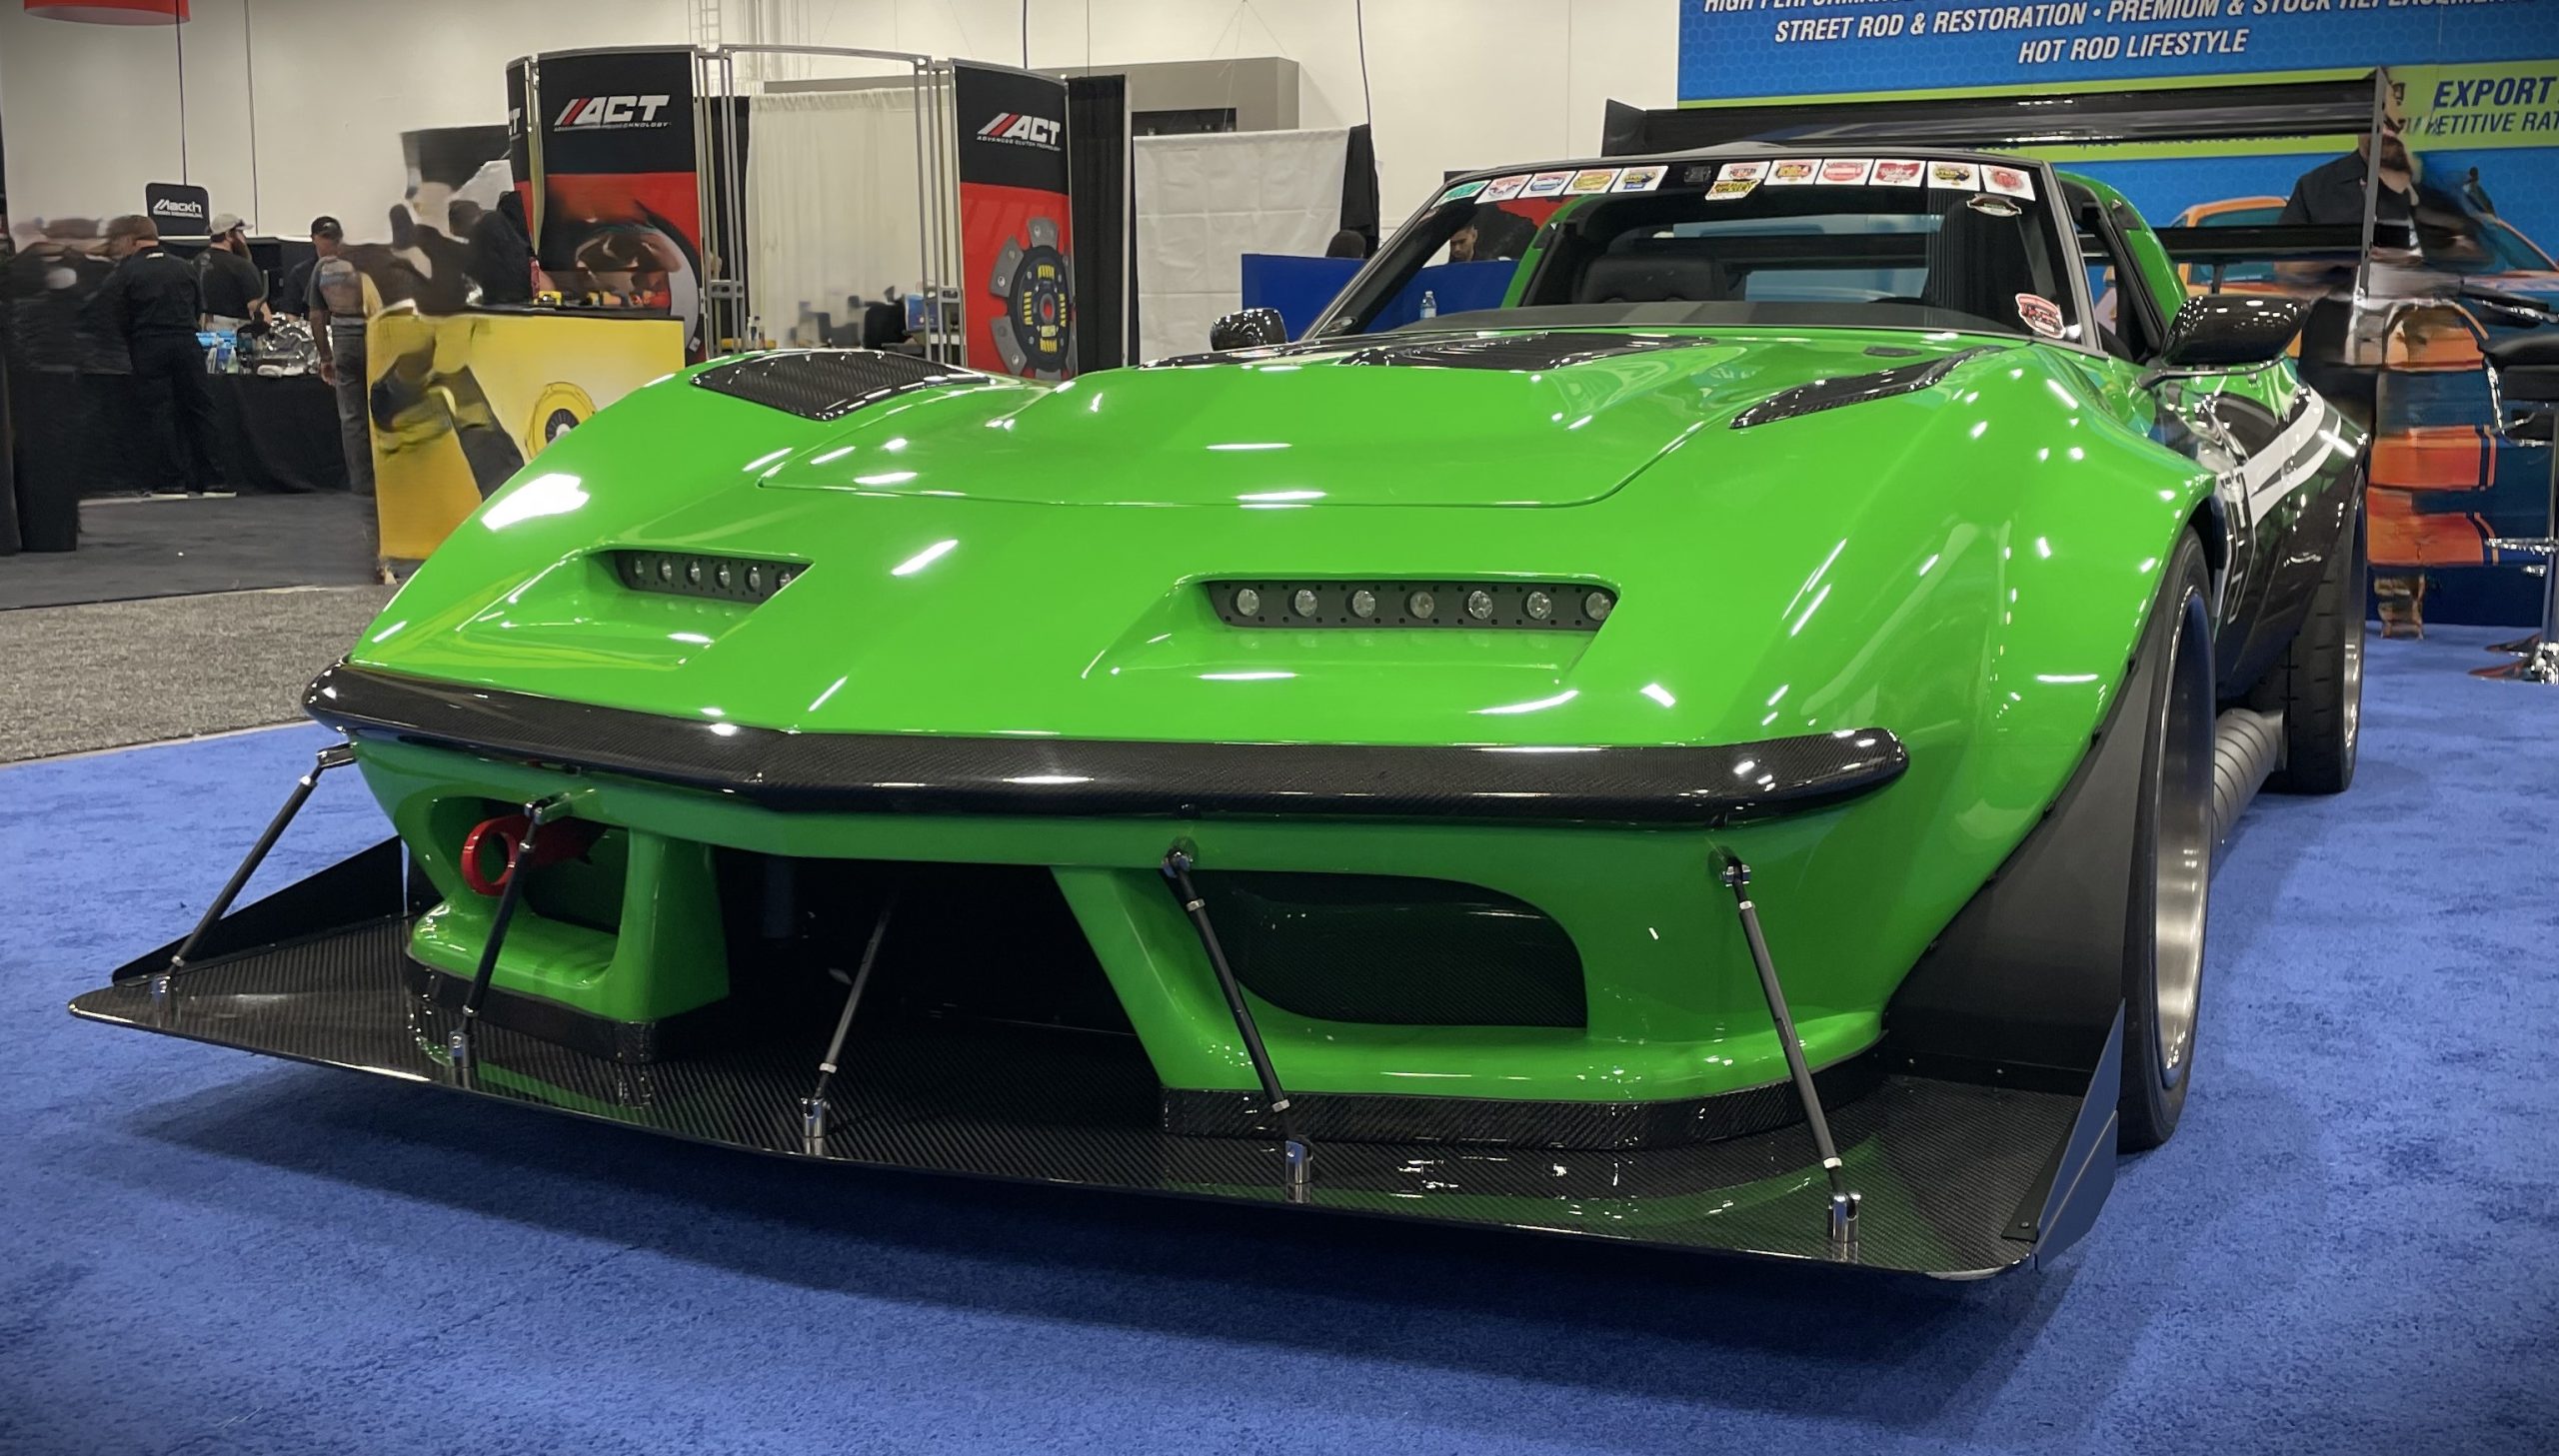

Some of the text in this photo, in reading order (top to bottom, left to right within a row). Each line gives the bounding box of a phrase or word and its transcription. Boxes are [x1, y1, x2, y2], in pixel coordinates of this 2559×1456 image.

[1774, 17, 1854, 42] STREET
[1857, 14, 1904, 38] ROD
[1910, 12, 1926, 34] &
[1932, 2, 2087, 34] RESTORATION
[2105, 0, 2220, 23] PREMIUM
[2017, 29, 2249, 64] HOT ROD LIFESTYLE
[2433, 76, 2558, 108] EXPORT
